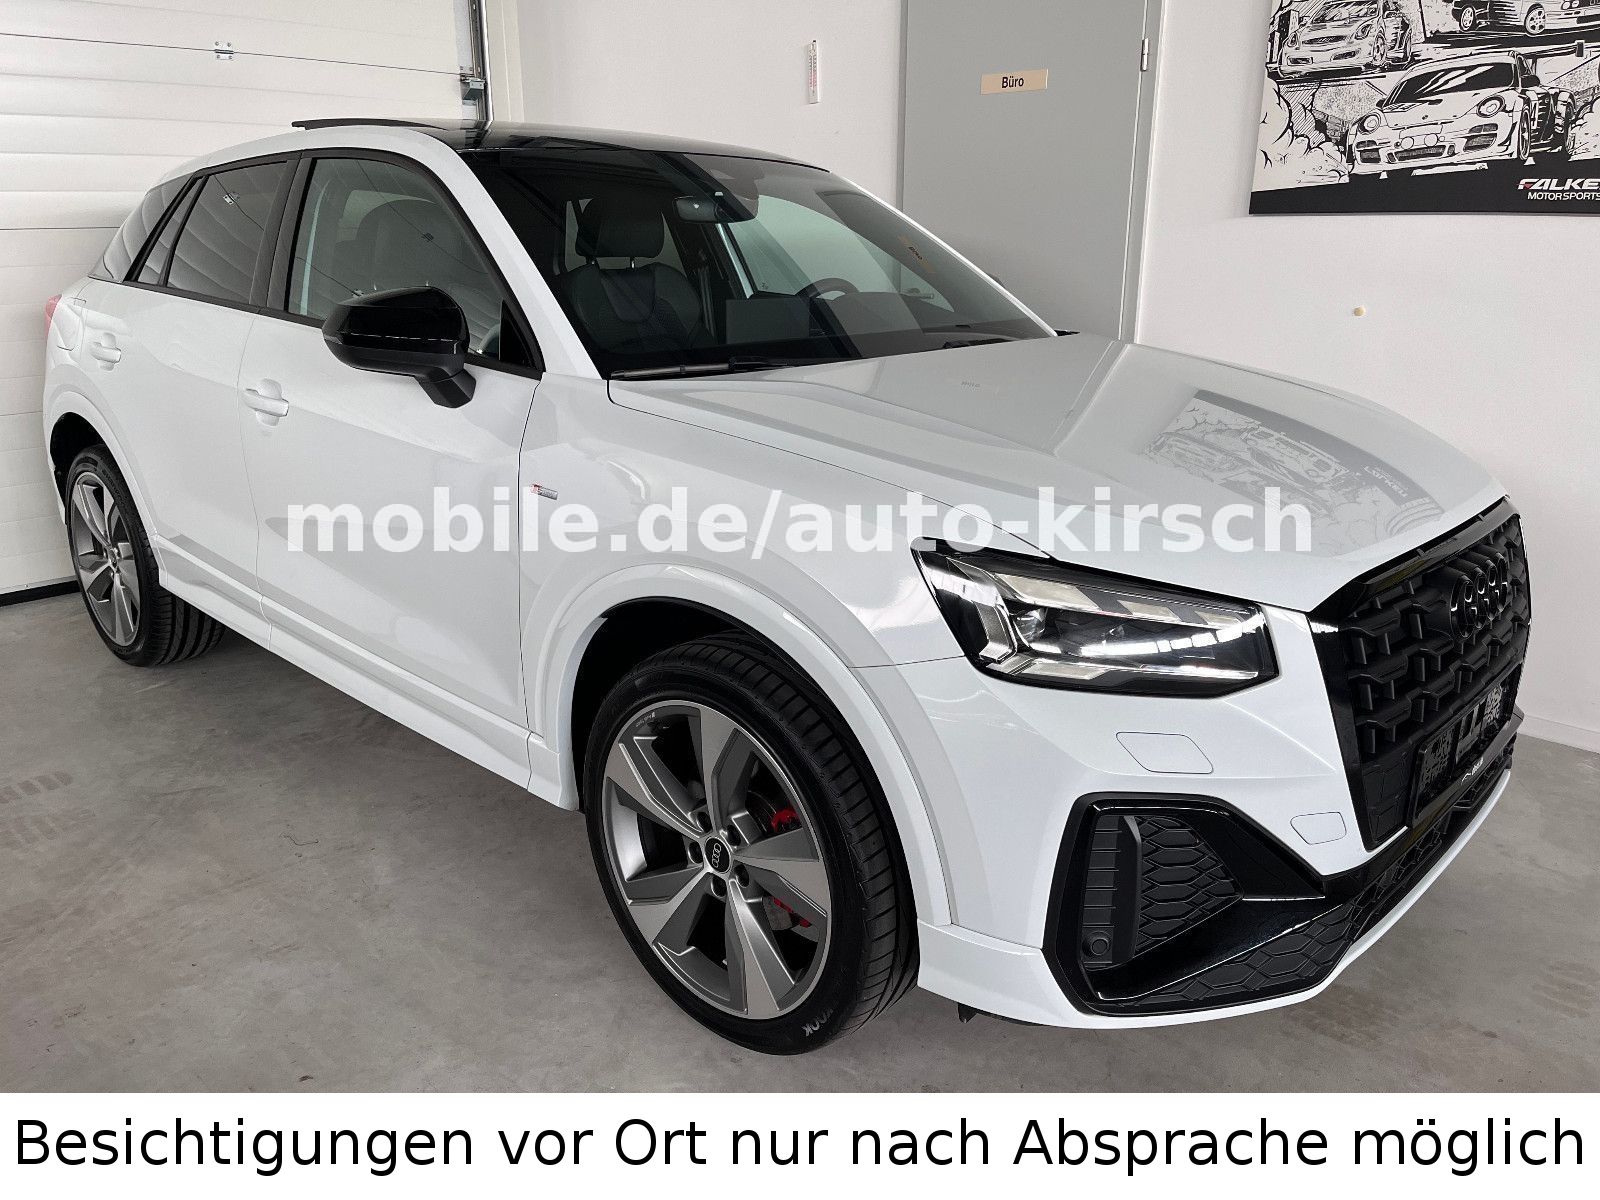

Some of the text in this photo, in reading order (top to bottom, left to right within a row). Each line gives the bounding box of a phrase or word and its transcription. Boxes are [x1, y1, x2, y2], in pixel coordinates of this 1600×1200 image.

[1001, 76, 1024, 89] Büro
[1517, 178, 1600, 190] FALKE
[1527, 191, 1600, 201] MOTORSPORTS
